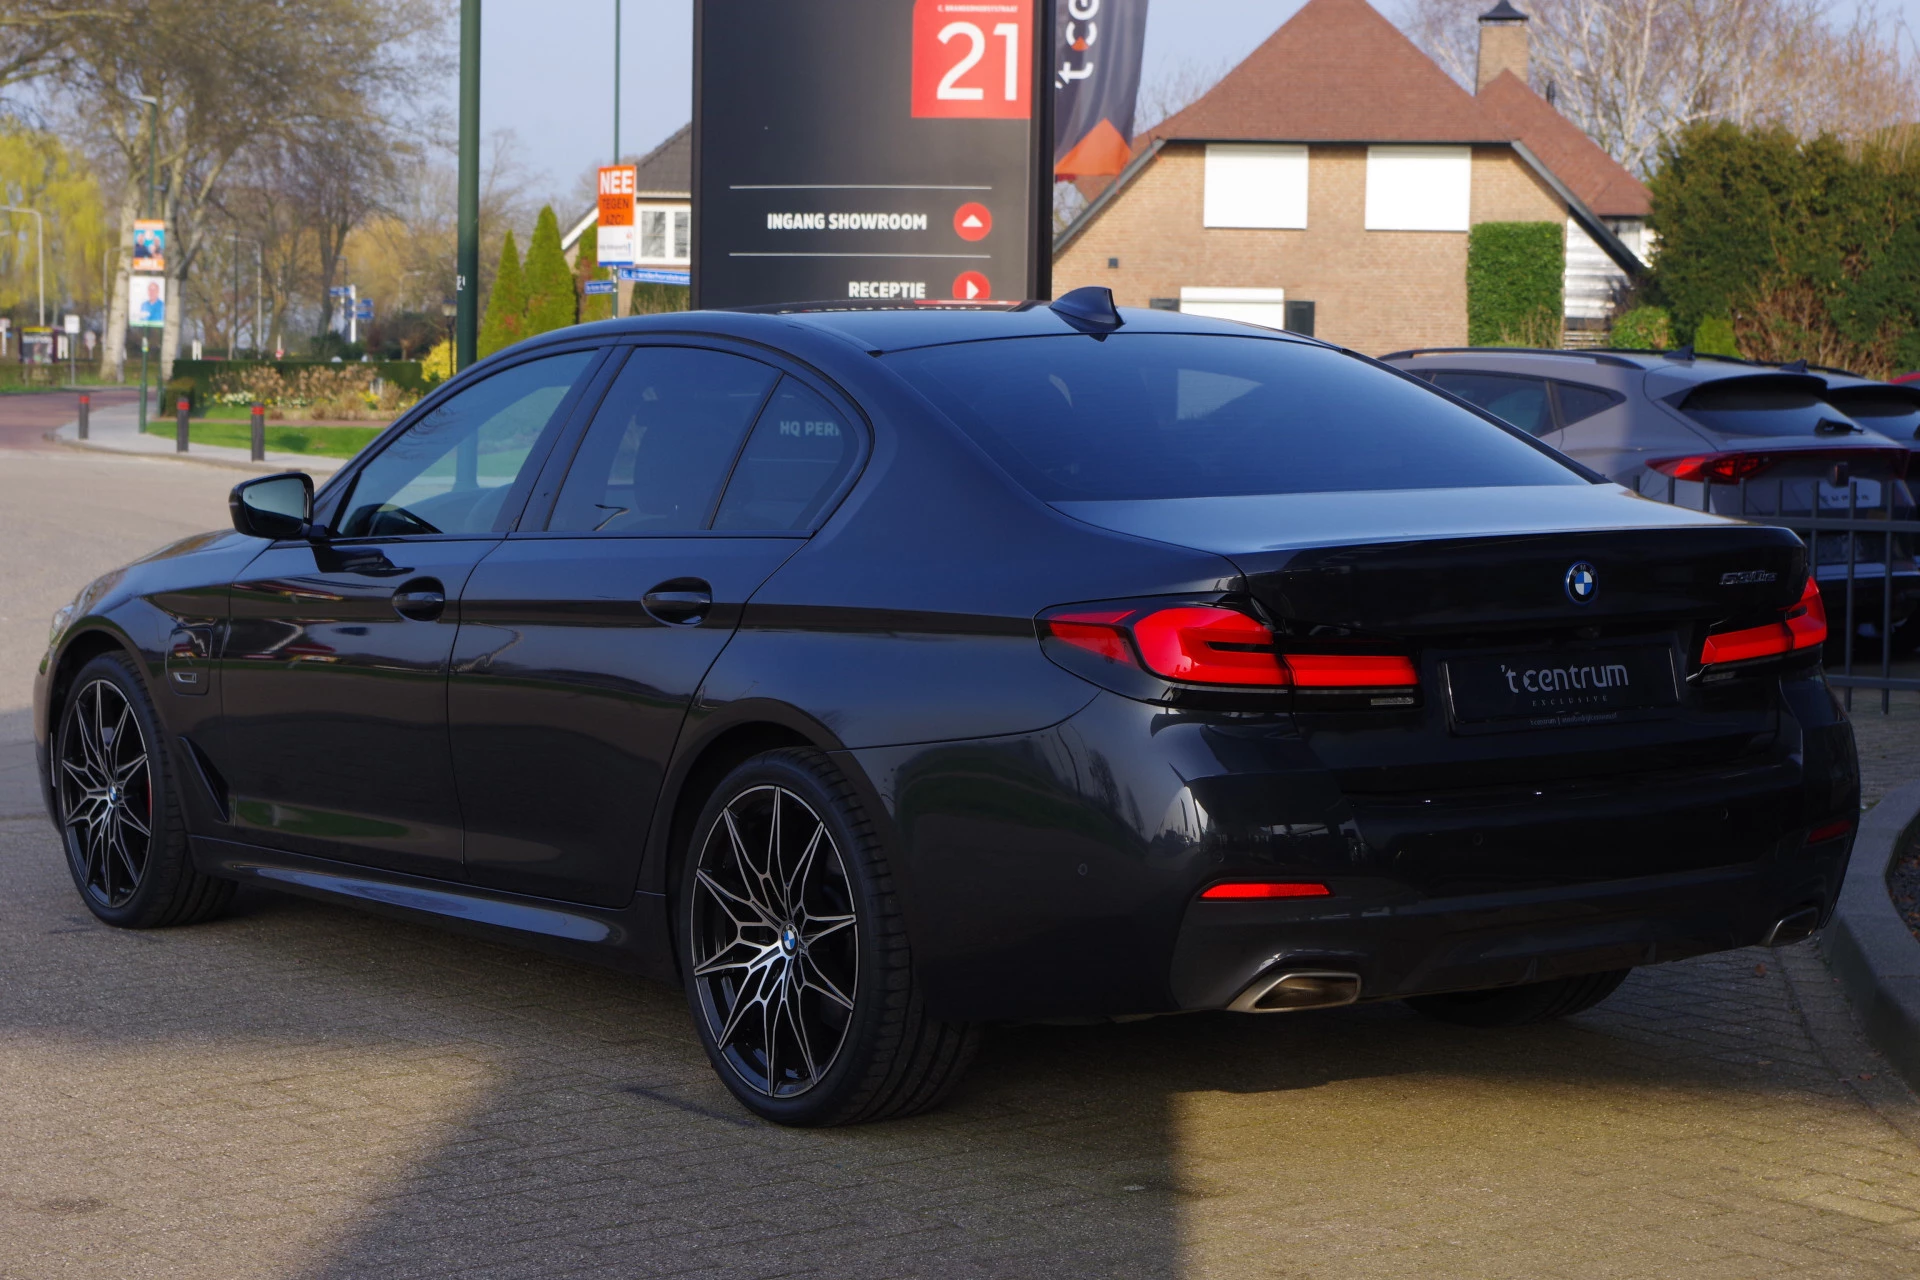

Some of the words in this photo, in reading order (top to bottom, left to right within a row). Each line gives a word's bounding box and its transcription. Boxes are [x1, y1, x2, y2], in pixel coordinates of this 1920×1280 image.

[936, 21, 1019, 102] 21
[600, 170, 633, 195] NEE
[602, 197, 630, 210] TEGEN
[767, 212, 825, 230] INGANG
[828, 212, 928, 230] SHOWROOM
[848, 281, 926, 299] RECEPTIE
[779, 420, 801, 437] HQ
[1500, 664, 1519, 694] 't
[1523, 664, 1630, 693] centrum
[1532, 694, 1608, 707] EXCLUSIVE
